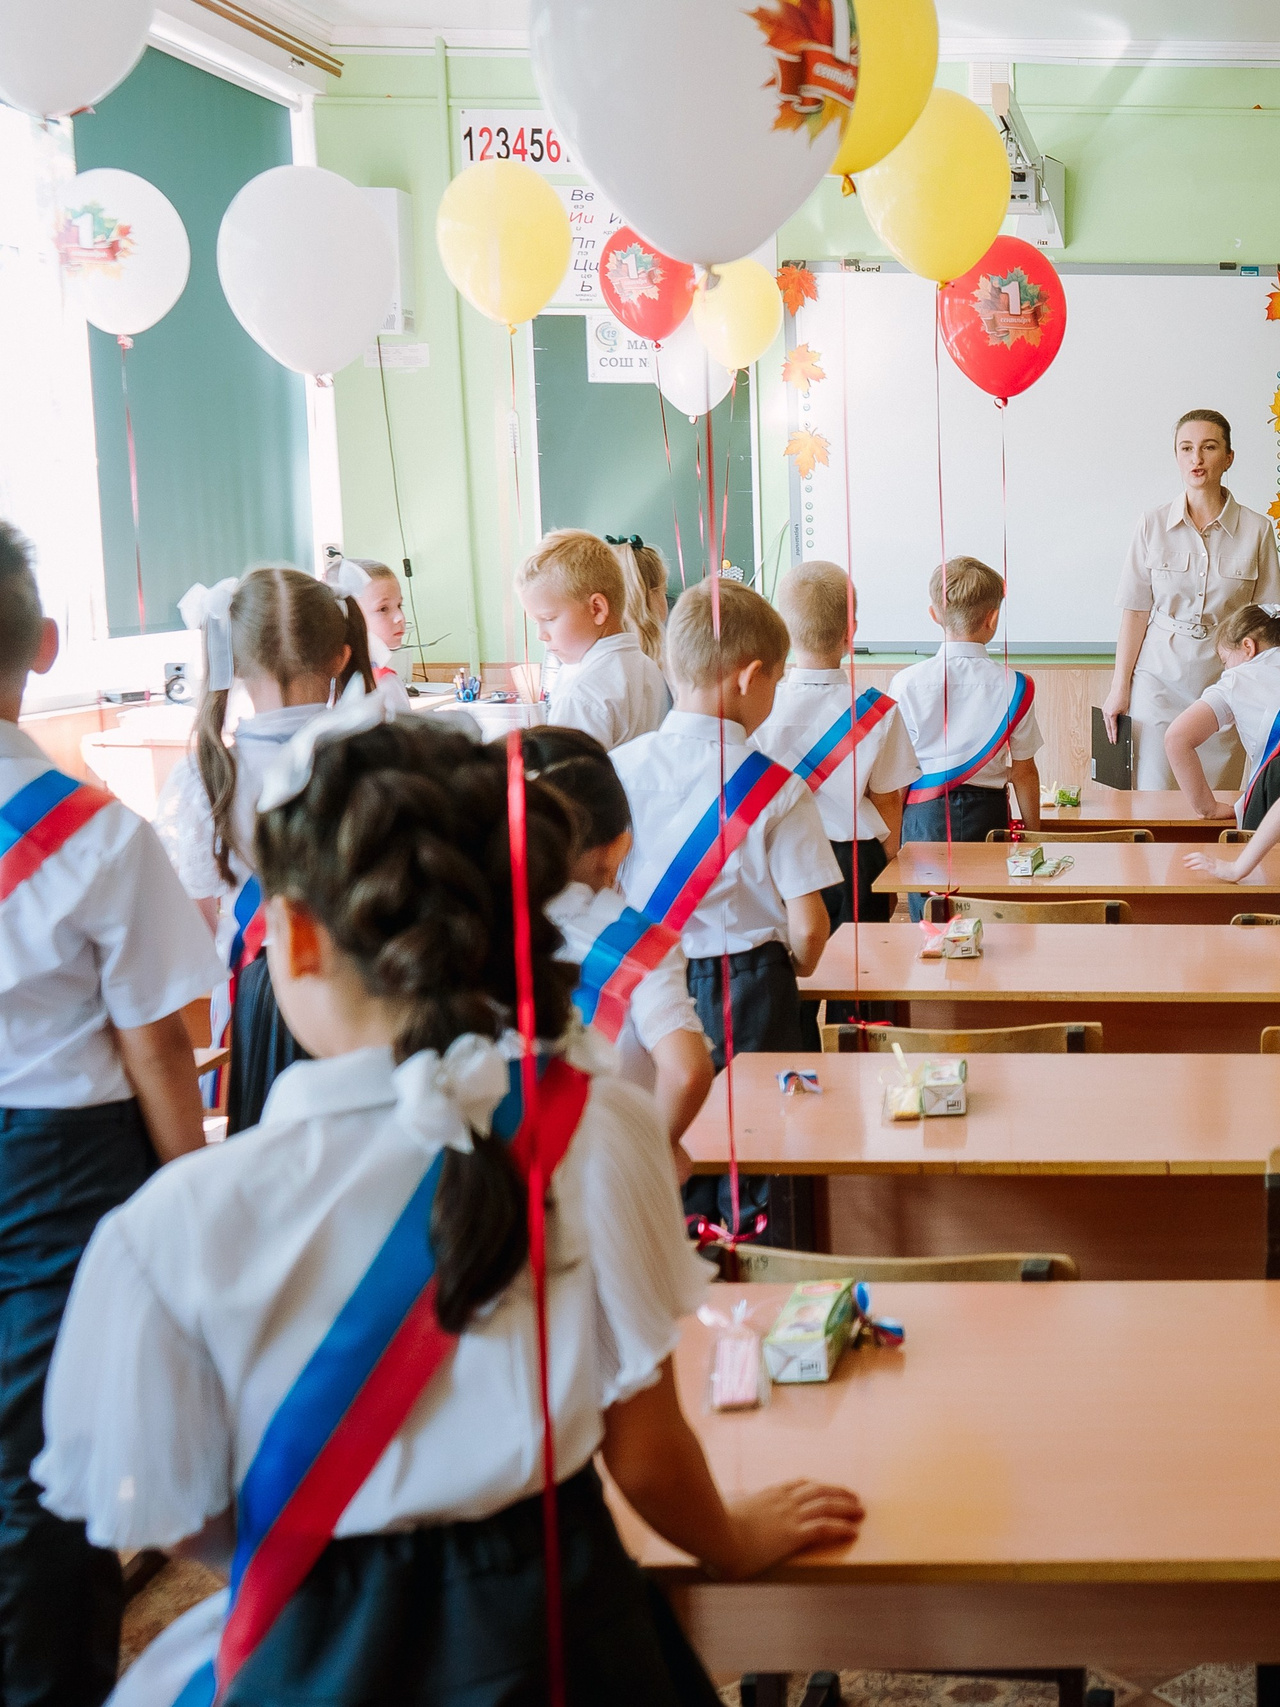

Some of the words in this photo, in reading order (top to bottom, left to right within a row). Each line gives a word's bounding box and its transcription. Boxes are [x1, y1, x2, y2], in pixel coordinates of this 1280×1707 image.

[463, 126, 571, 163] 123456
[627, 340, 648, 350] МА
[599, 357, 634, 368] СОШ
